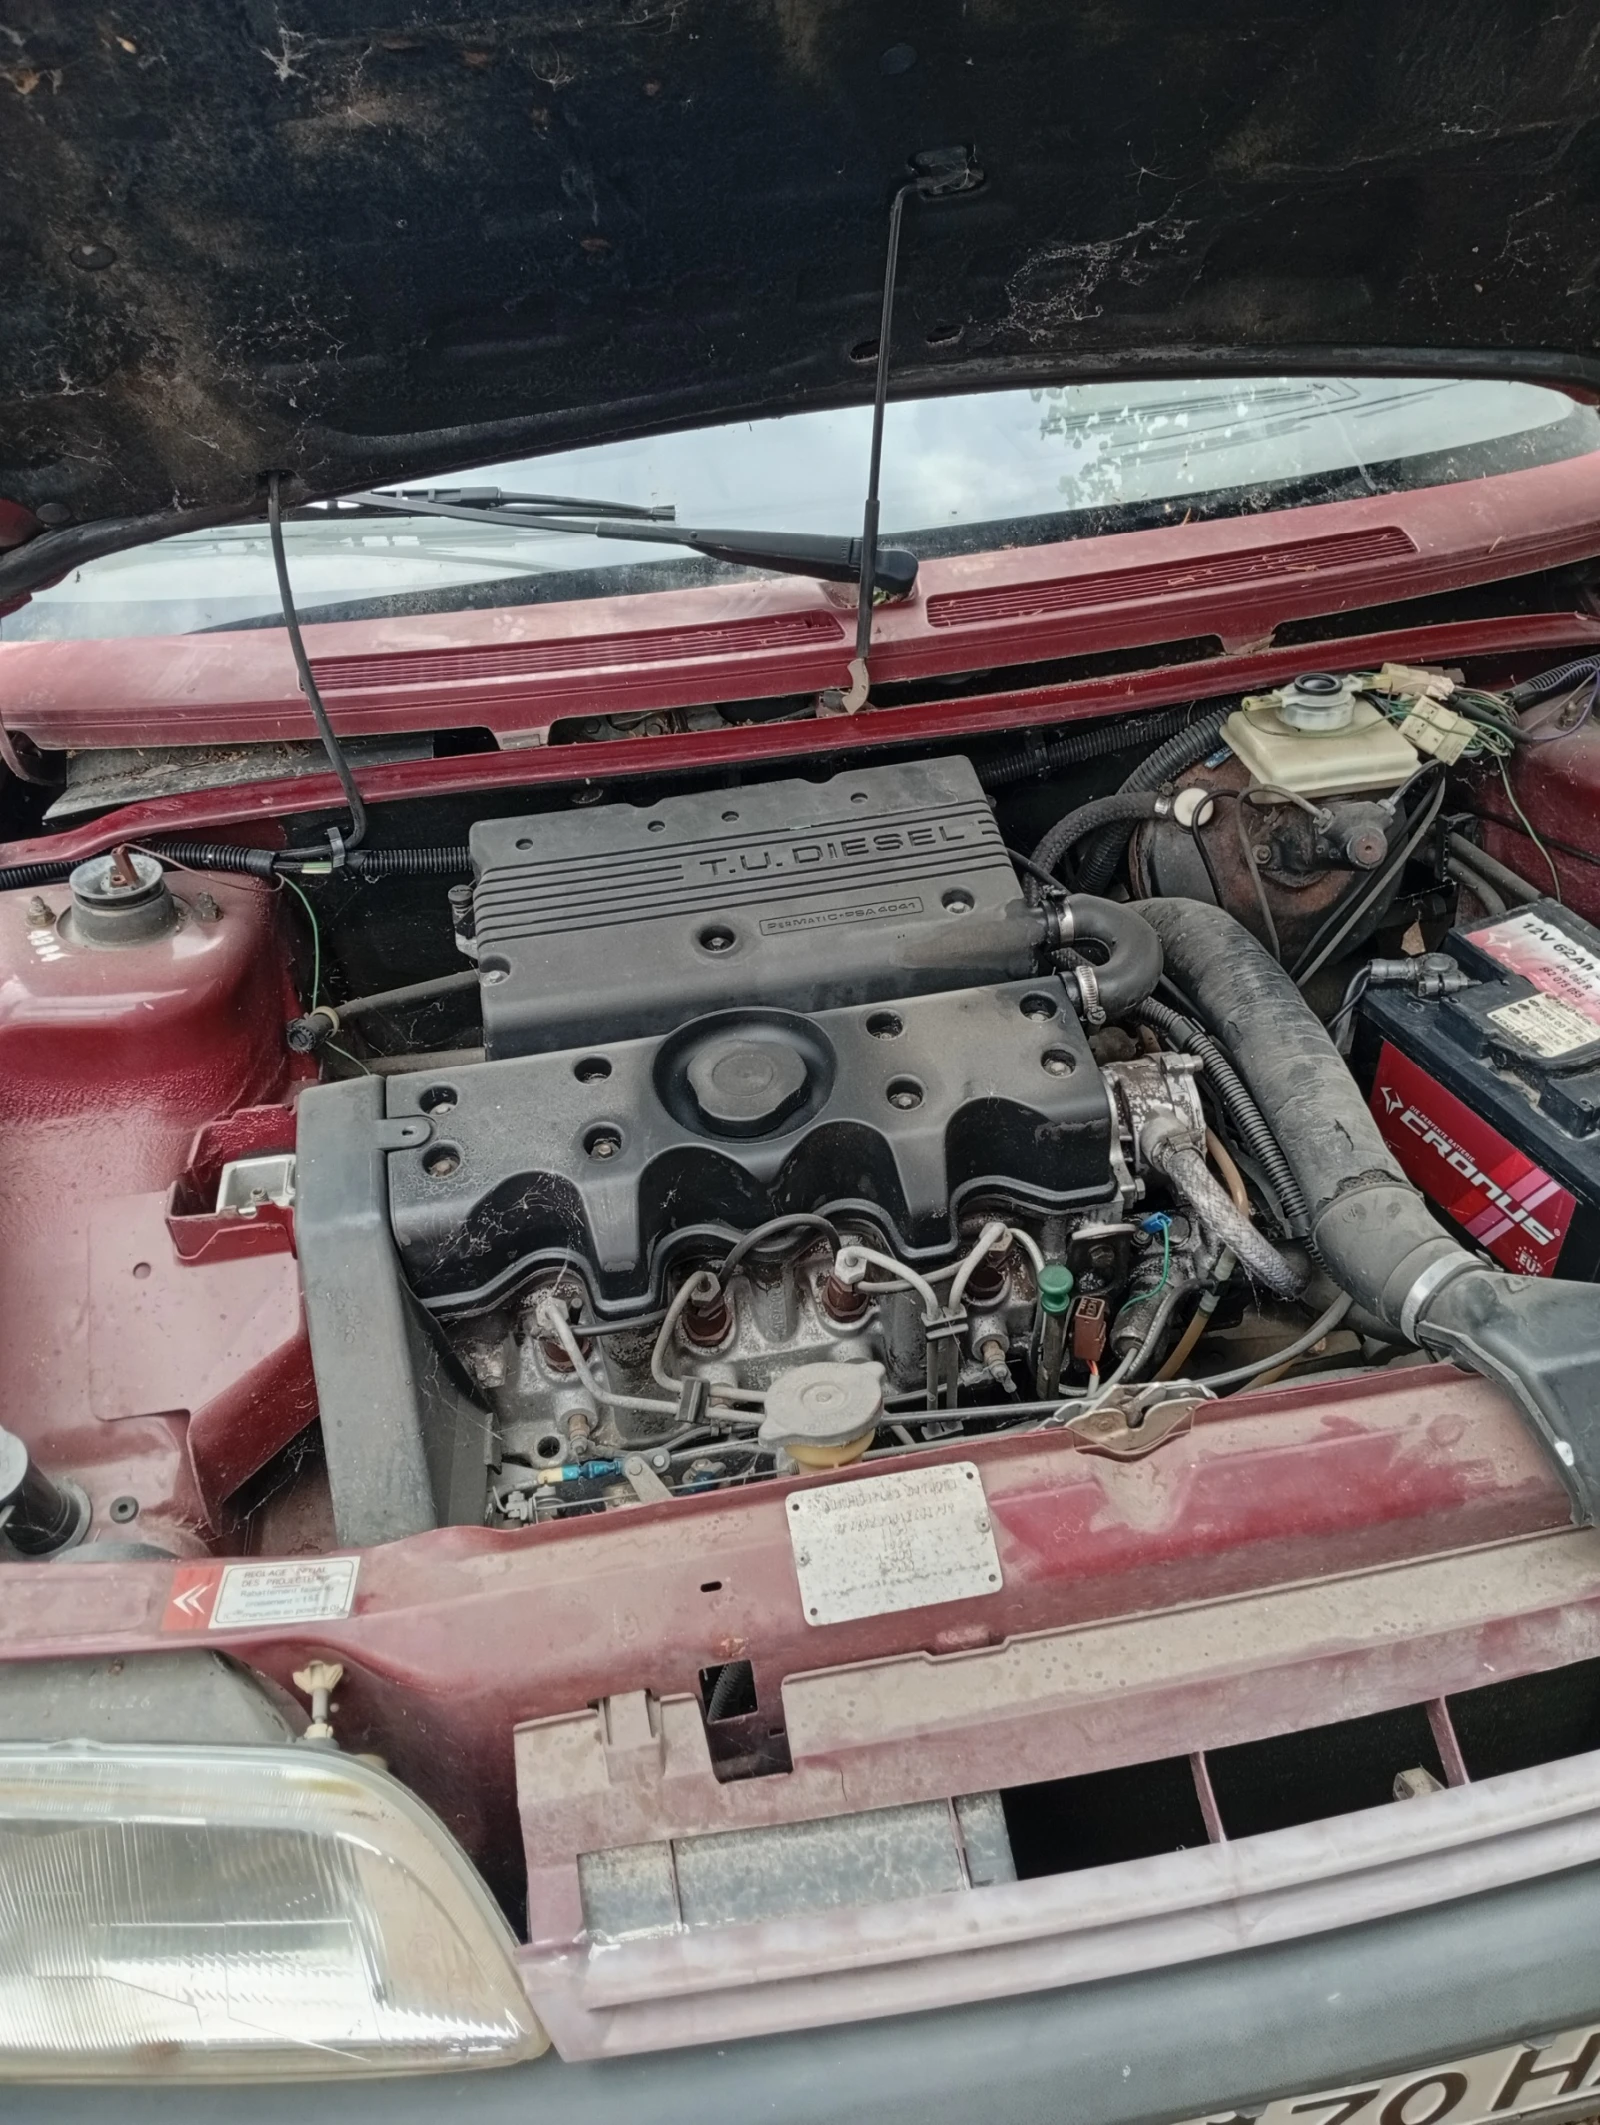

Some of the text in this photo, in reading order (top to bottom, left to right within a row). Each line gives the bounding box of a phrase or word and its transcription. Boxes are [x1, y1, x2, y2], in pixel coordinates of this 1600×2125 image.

[700, 826, 965, 875] T.U. DIESEL
[878, 902, 916, 913] 4041
[1522, 921, 1595, 972] 12V 62Ah
[1409, 1105, 1476, 1163] DIE PERFEKTE BATTERIE
[1400, 1109, 1556, 1246] CRONUS
